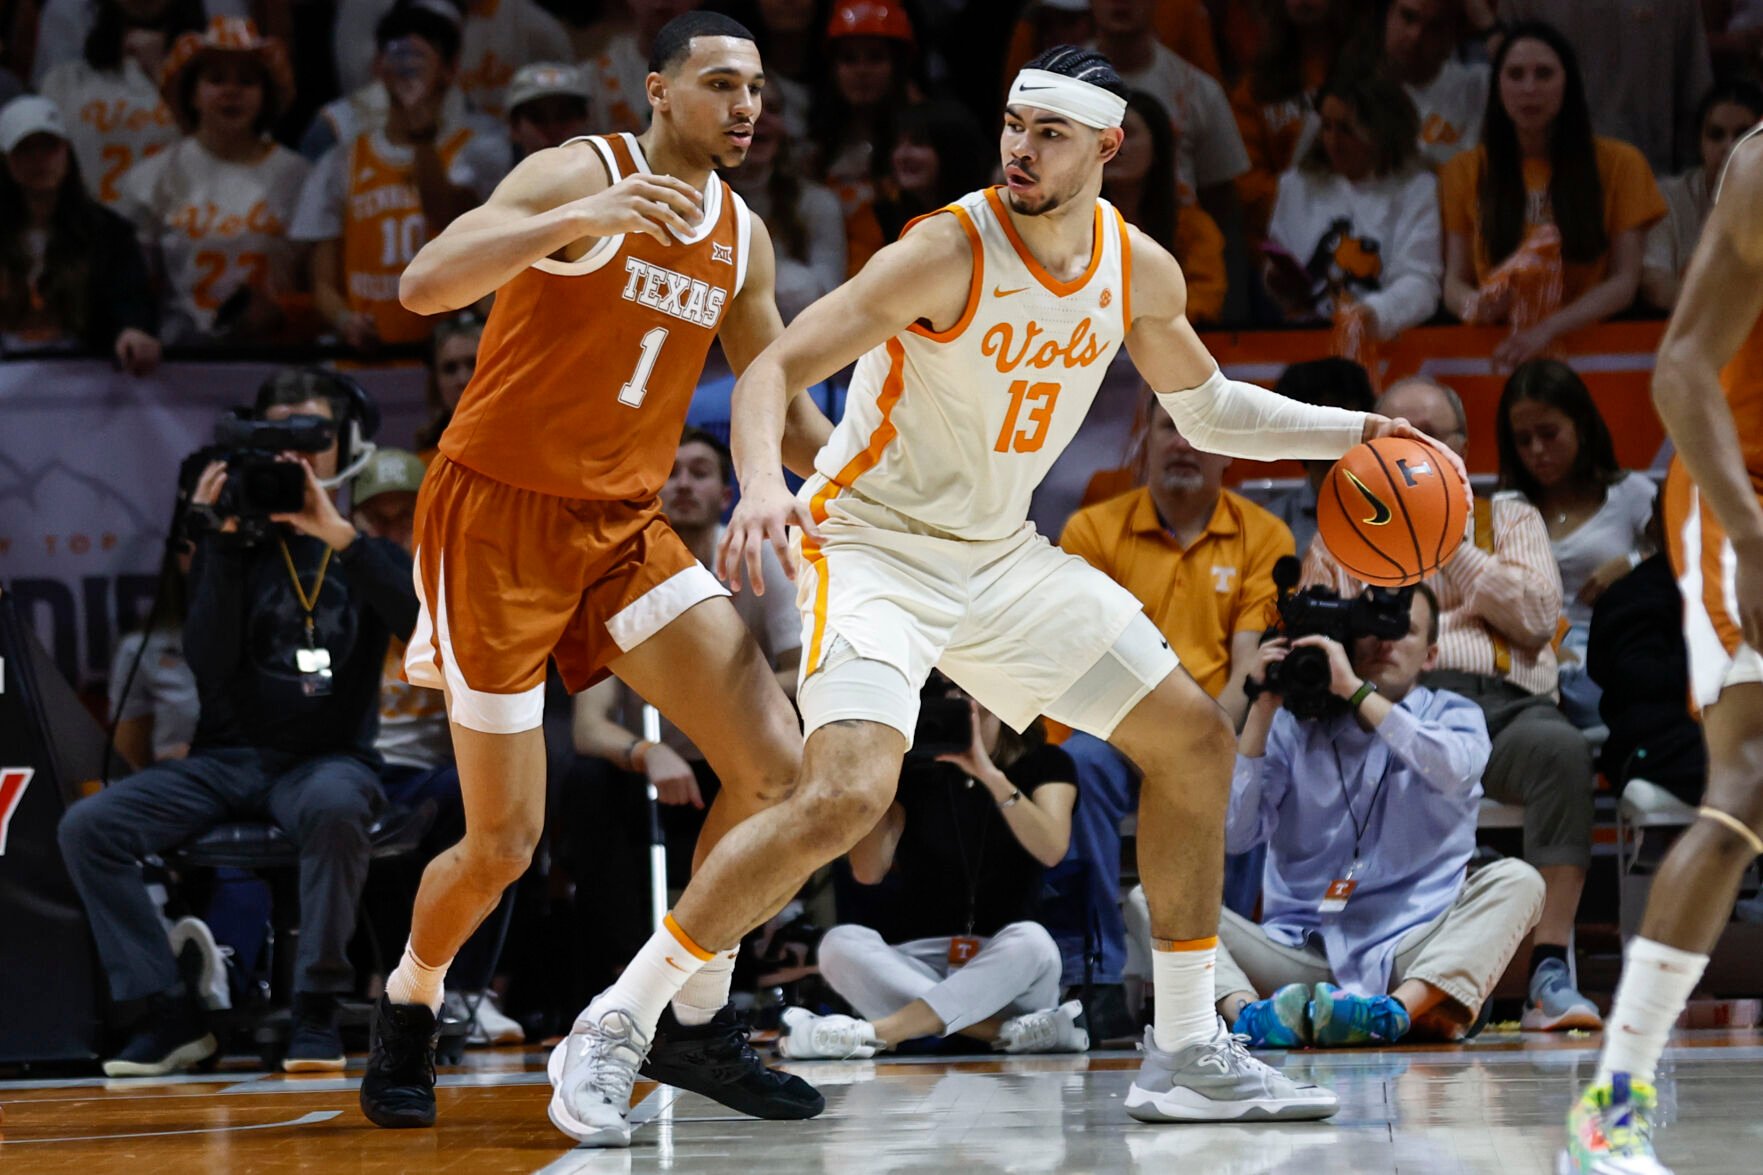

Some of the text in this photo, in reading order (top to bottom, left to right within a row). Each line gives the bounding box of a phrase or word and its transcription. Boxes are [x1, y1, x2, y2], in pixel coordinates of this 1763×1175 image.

[81, 100, 174, 132] Vol
[622, 255, 728, 329] TEXAS
[617, 326, 670, 409] 1
[981, 317, 1111, 373] Vols
[994, 380, 1061, 453] 13
[1211, 566, 1237, 593] T
